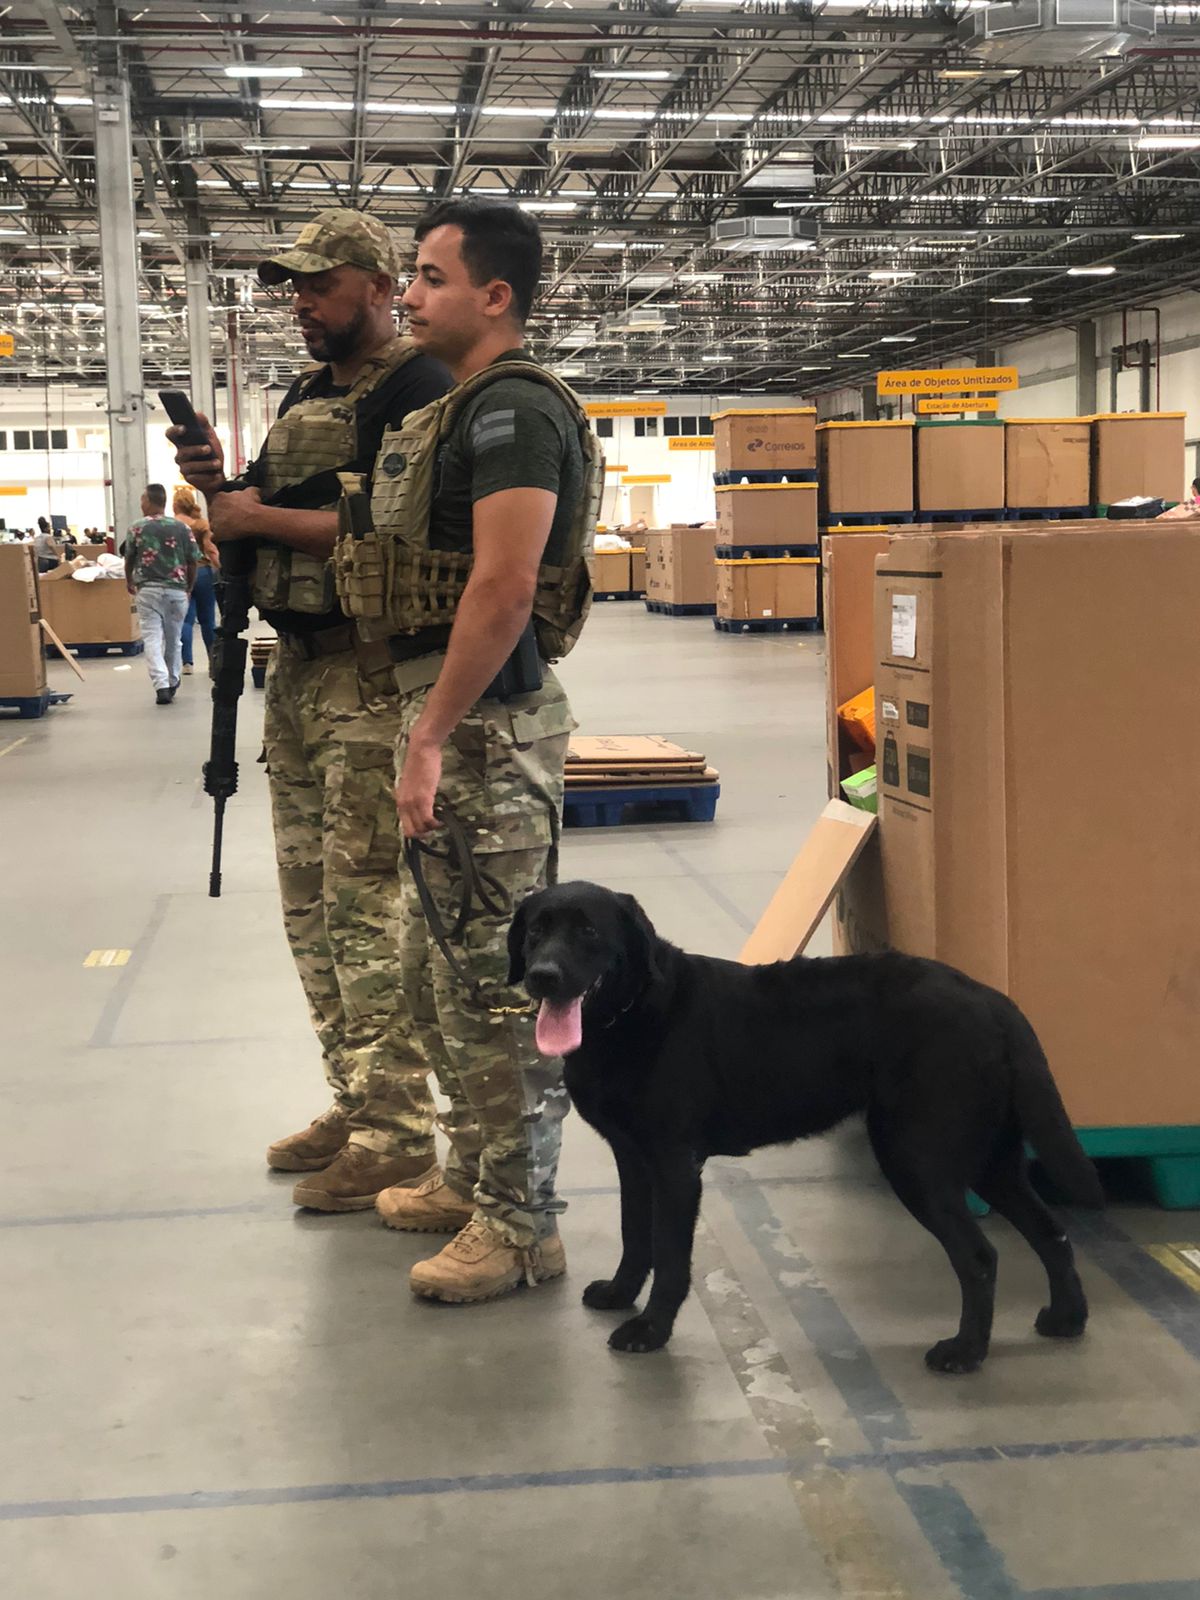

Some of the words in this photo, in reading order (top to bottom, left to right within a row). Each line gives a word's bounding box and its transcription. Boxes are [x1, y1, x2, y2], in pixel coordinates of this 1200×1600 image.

[885, 377, 907, 388] Área
[909, 378, 921, 387] de
[924, 376, 961, 388] Objetos
[963, 375, 1013, 385] Unitizados
[926, 402, 950, 410] Estação
[765, 442, 805, 451] Correios
